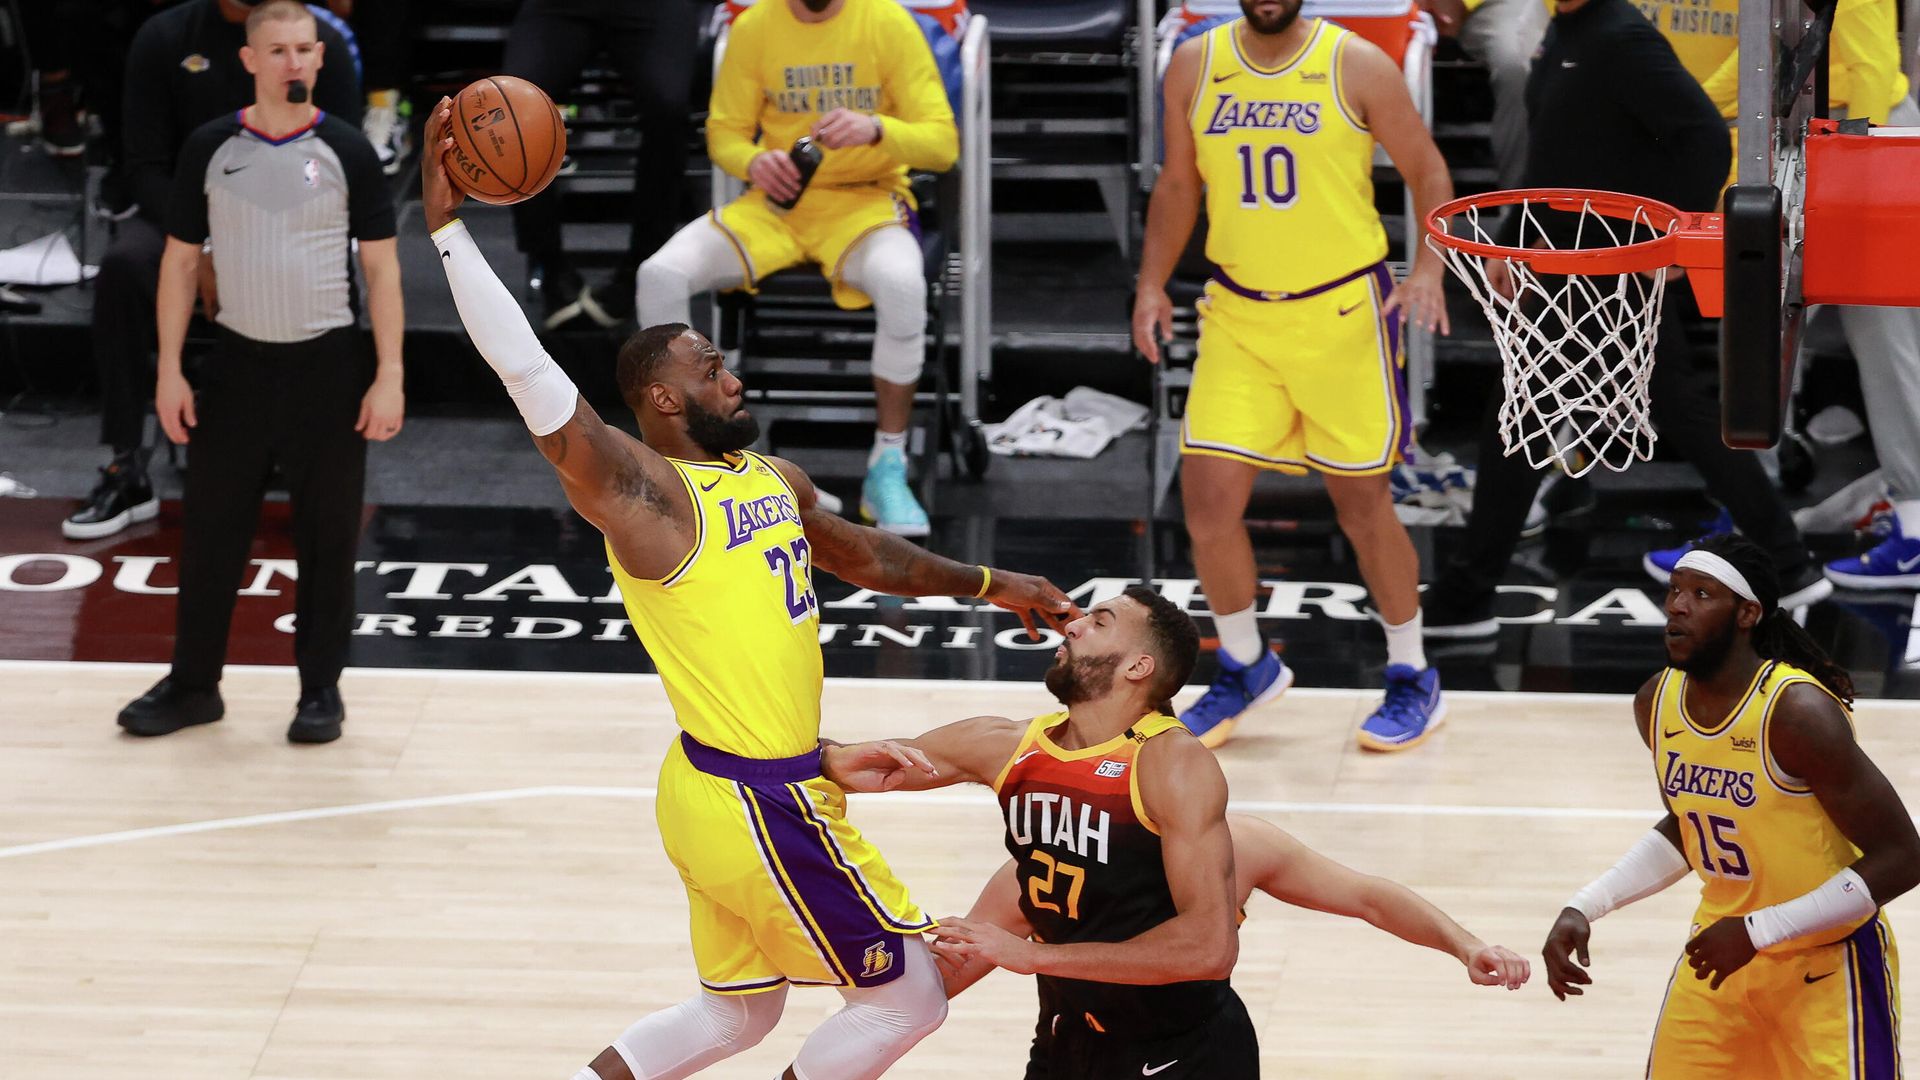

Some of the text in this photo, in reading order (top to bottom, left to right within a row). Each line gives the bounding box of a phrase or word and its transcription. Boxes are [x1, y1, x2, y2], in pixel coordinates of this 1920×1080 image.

[1671, 9, 1738, 35] HISTOR
[1203, 93, 1321, 135] LAKERS
[1237, 144, 1298, 209] 10
[718, 492, 802, 552] LAKERS
[1664, 751, 1758, 808] LAKERS
[1009, 792, 1111, 865] UTAH
[1686, 811, 1752, 878] 15
[1028, 849, 1086, 921] 27
